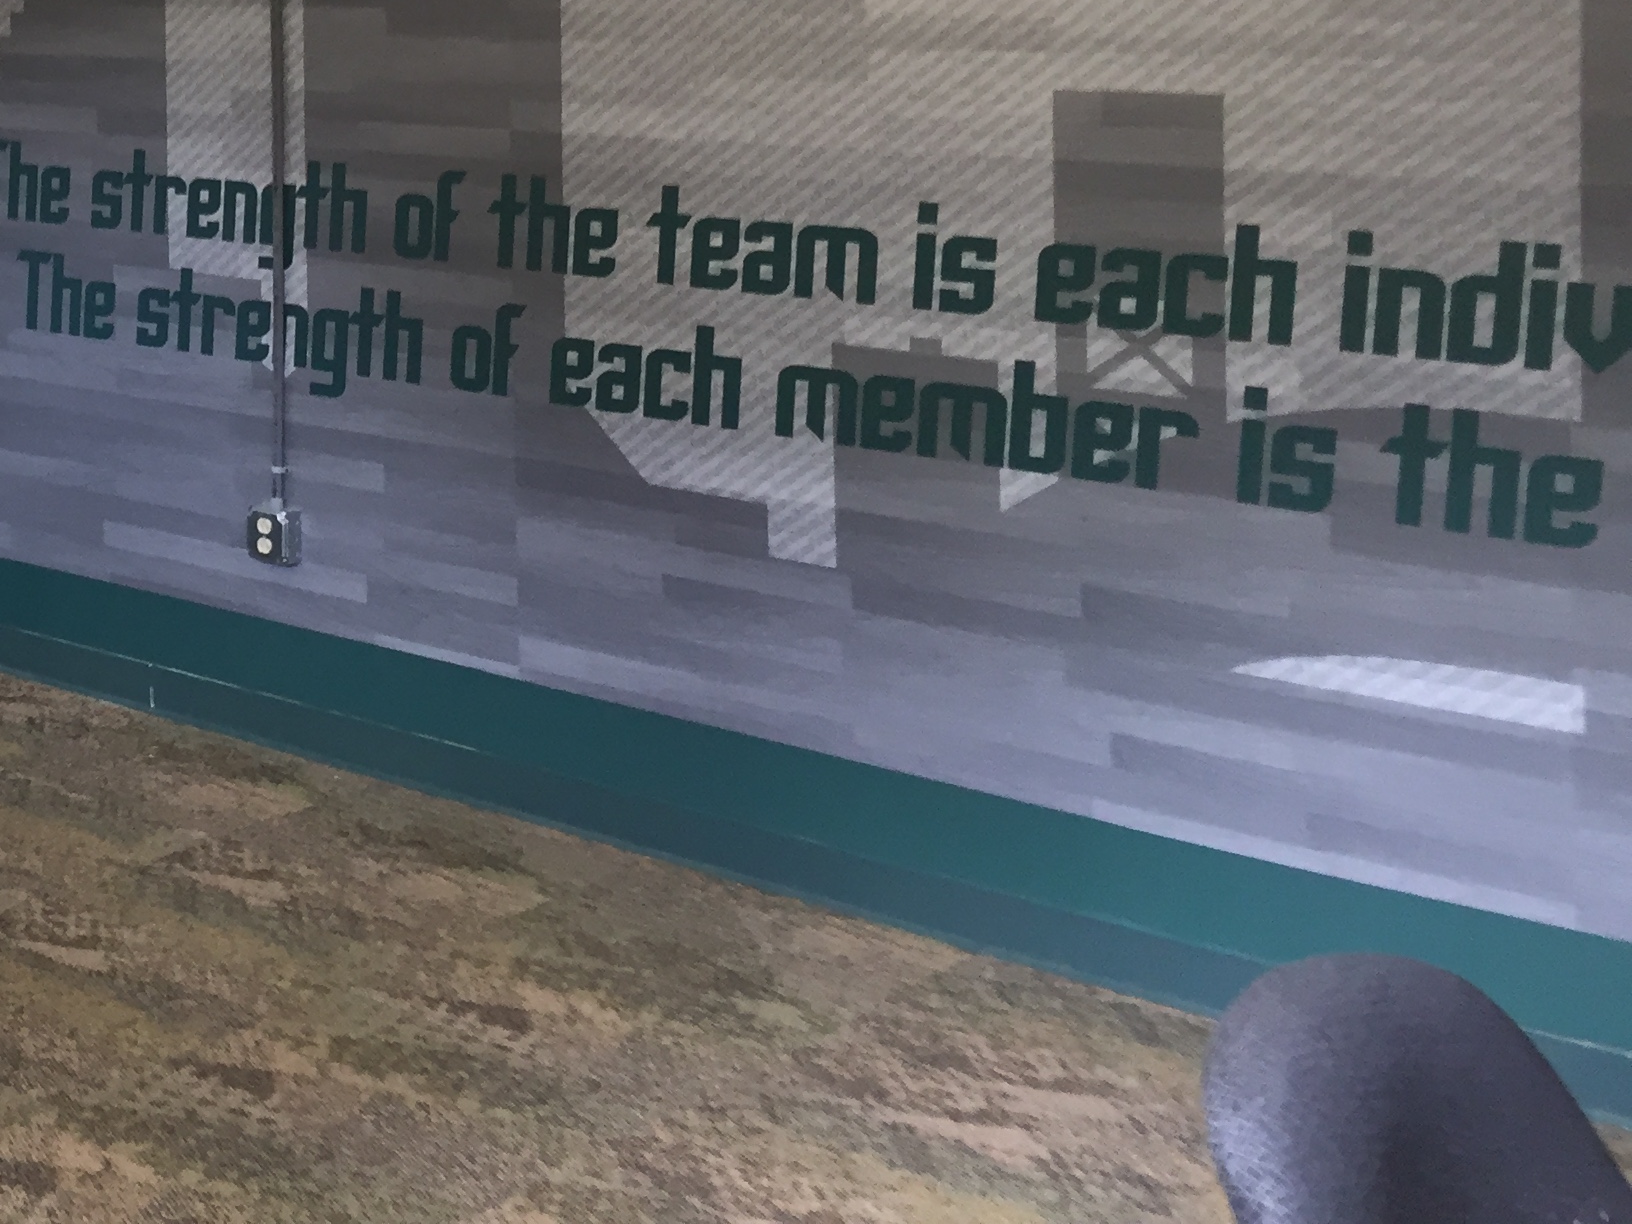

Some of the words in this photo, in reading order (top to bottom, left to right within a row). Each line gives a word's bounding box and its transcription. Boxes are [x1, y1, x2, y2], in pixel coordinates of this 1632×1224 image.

[90, 148, 369, 271] strength
[392, 169, 466, 262] of
[486, 173, 619, 278] the
[645, 185, 879, 305] team
[911, 202, 998, 315] is
[1033, 225, 1299, 346] each
[1339, 230, 1632, 374] indiv
[15, 248, 117, 341] The
[134, 267, 425, 400] strength
[449, 303, 526, 398] of
[548, 326, 743, 430] each
[774, 359, 1201, 491] member
[1234, 386, 1338, 514] is
[1379, 402, 1606, 550] the
